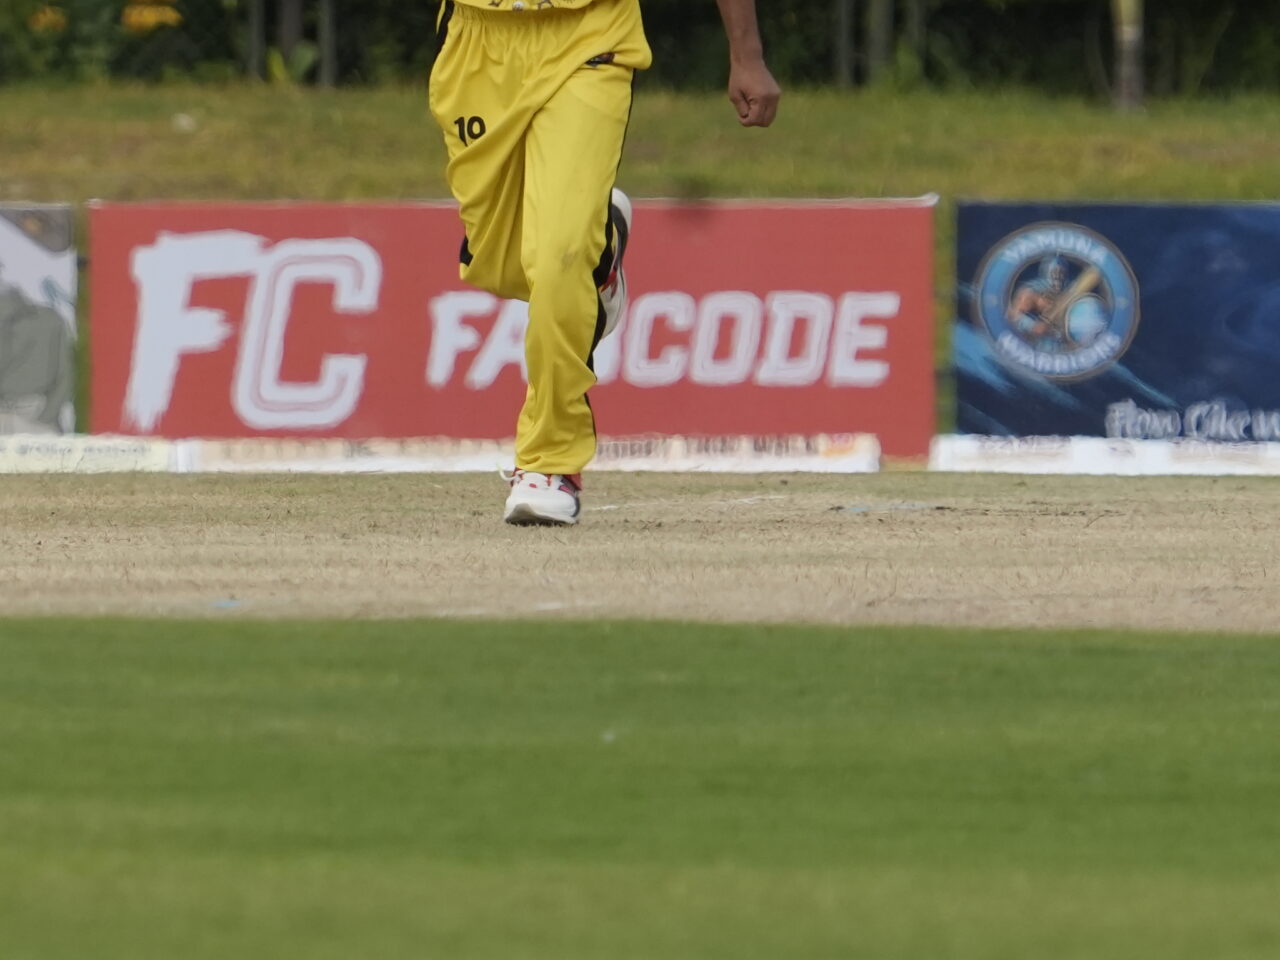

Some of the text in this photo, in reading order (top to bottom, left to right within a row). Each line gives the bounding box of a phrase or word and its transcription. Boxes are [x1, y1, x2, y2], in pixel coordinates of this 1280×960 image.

[453, 116, 487, 147] 10
[121, 229, 382, 432] FC
[426, 290, 900, 389] FACODE
